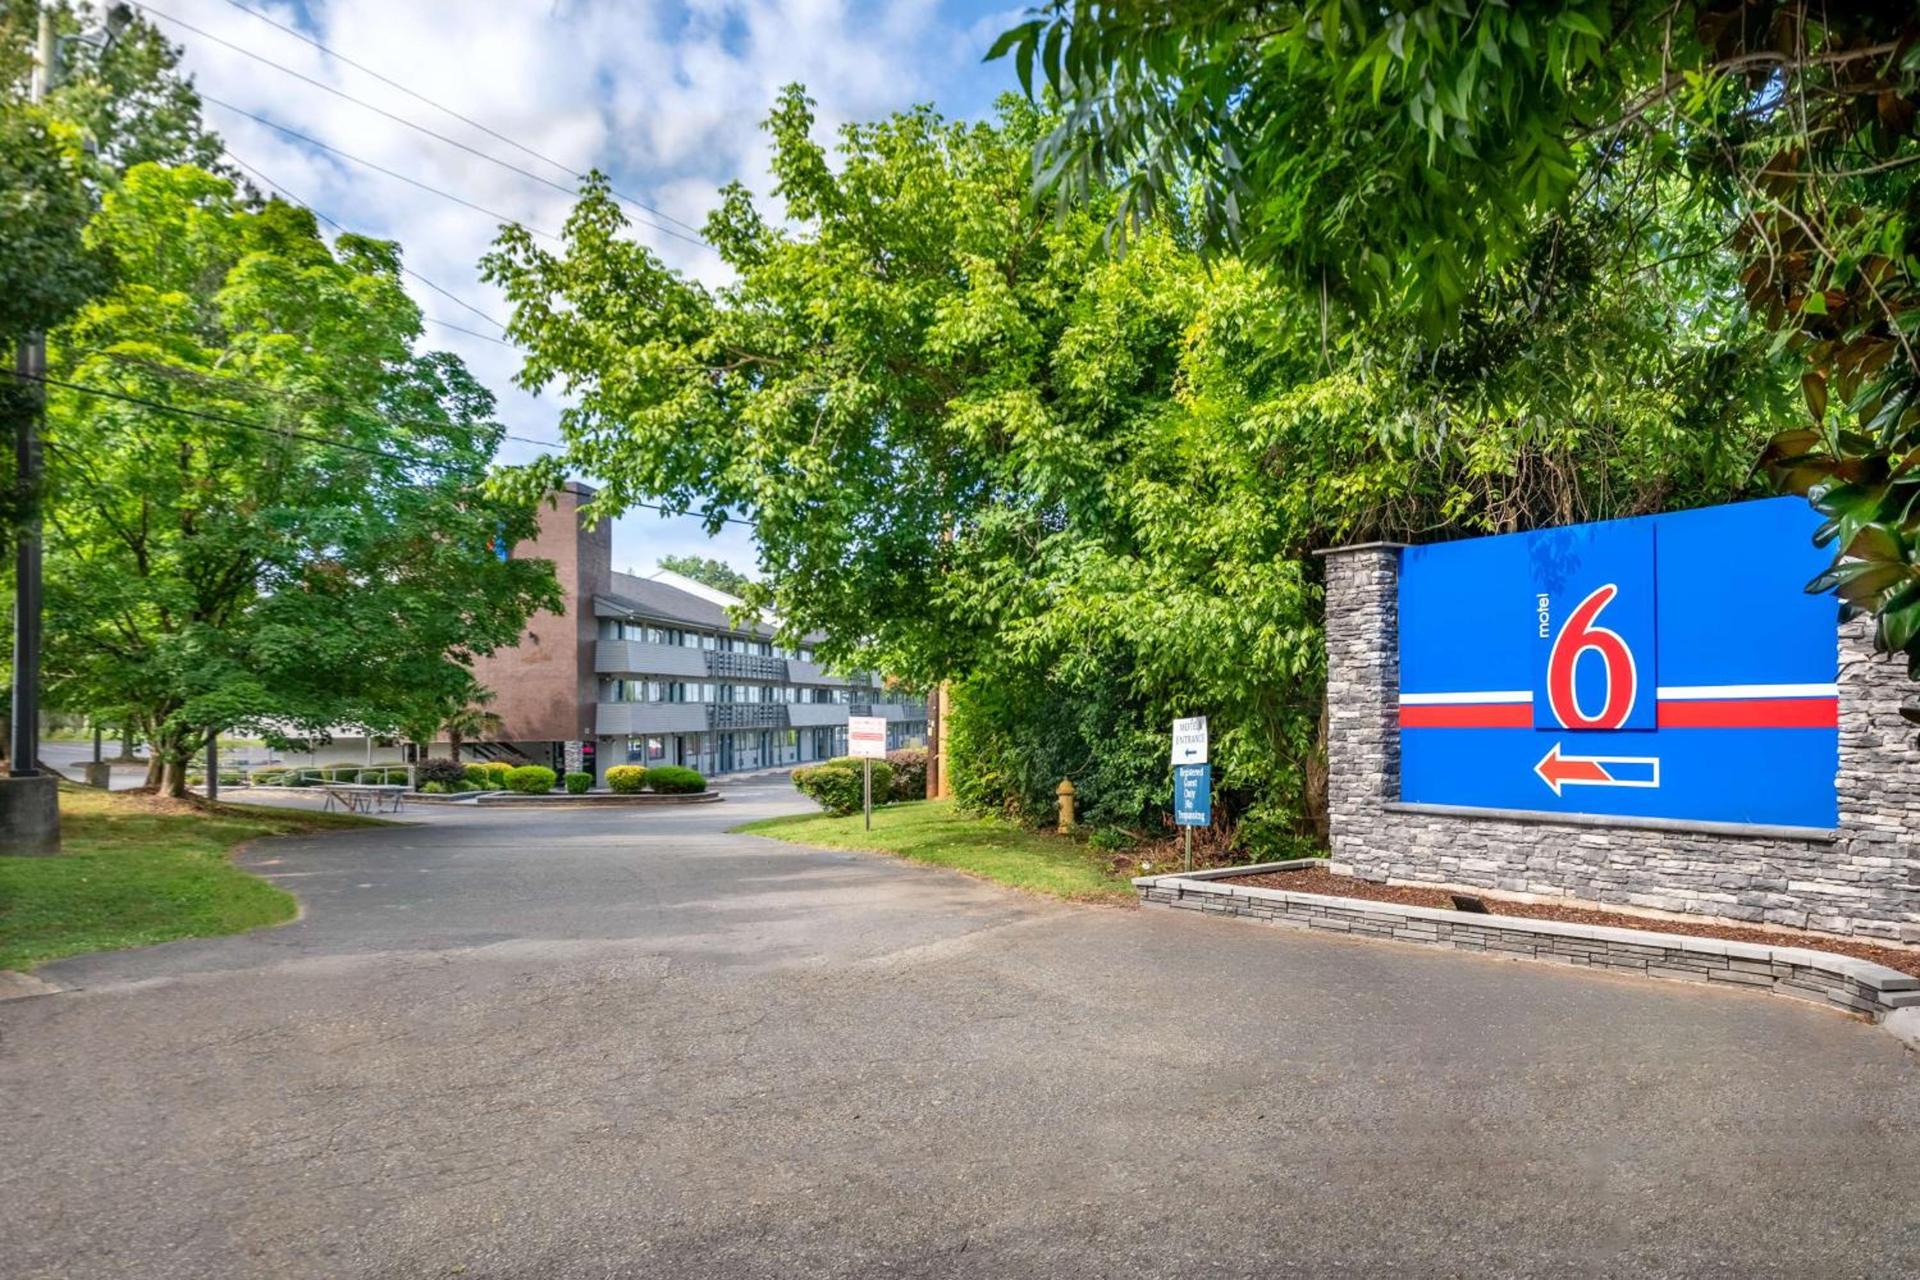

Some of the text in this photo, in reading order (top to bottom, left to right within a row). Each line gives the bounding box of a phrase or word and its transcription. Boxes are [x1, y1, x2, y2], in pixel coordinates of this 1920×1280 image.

[1536, 583, 1637, 729] motel 6
[1176, 734, 1205, 744] ENTRANCE
[1179, 767, 1204, 779] Registered
[1183, 778, 1198, 788] Guest
[1183, 788, 1196, 799] Only
[1184, 800, 1193, 809] No
[1178, 810, 1205, 823] Trespassing
